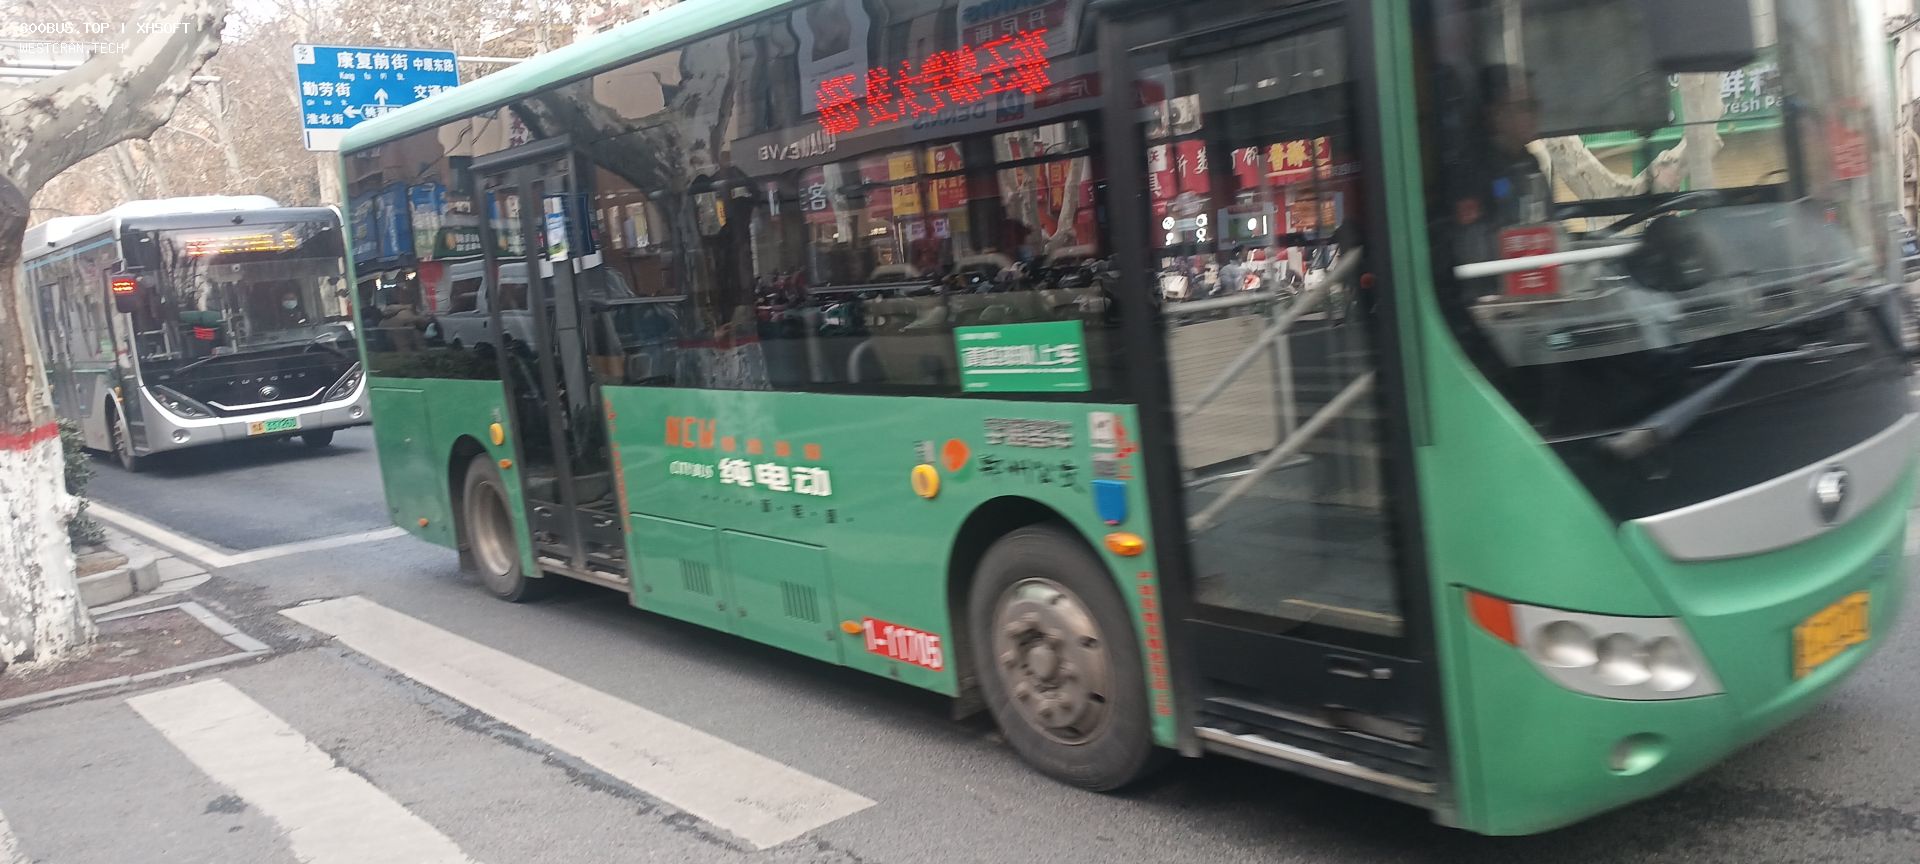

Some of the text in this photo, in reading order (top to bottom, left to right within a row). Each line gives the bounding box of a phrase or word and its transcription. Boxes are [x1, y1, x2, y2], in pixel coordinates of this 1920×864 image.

[337, 50, 409, 71] 康复前街
[1722, 97, 1761, 114] resh
[719, 457, 833, 497] 纯电动
